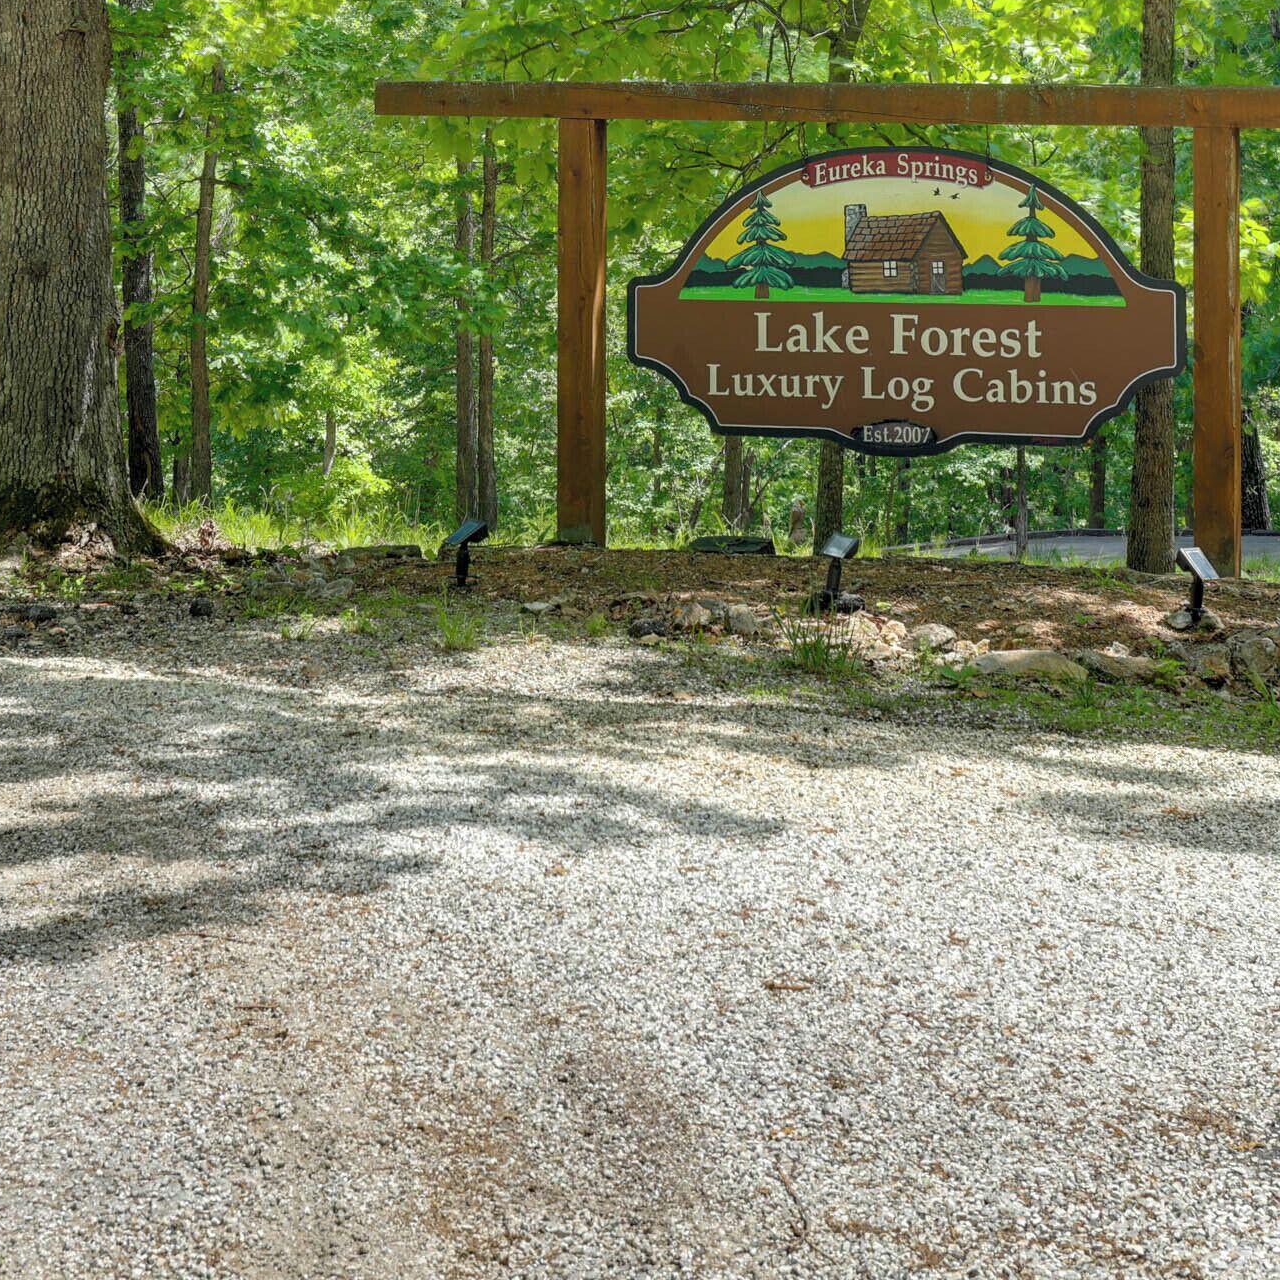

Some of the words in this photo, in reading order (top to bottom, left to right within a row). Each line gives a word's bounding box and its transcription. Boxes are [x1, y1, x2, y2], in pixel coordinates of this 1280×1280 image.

[814, 154, 887, 186] Eureka
[897, 153, 978, 188] Springs
[753, 312, 870, 354] Lake
[889, 313, 1043, 359] Forest
[706, 363, 843, 410] Luxury
[860, 366, 935, 412] Log
[953, 367, 1098, 406] Cabins
